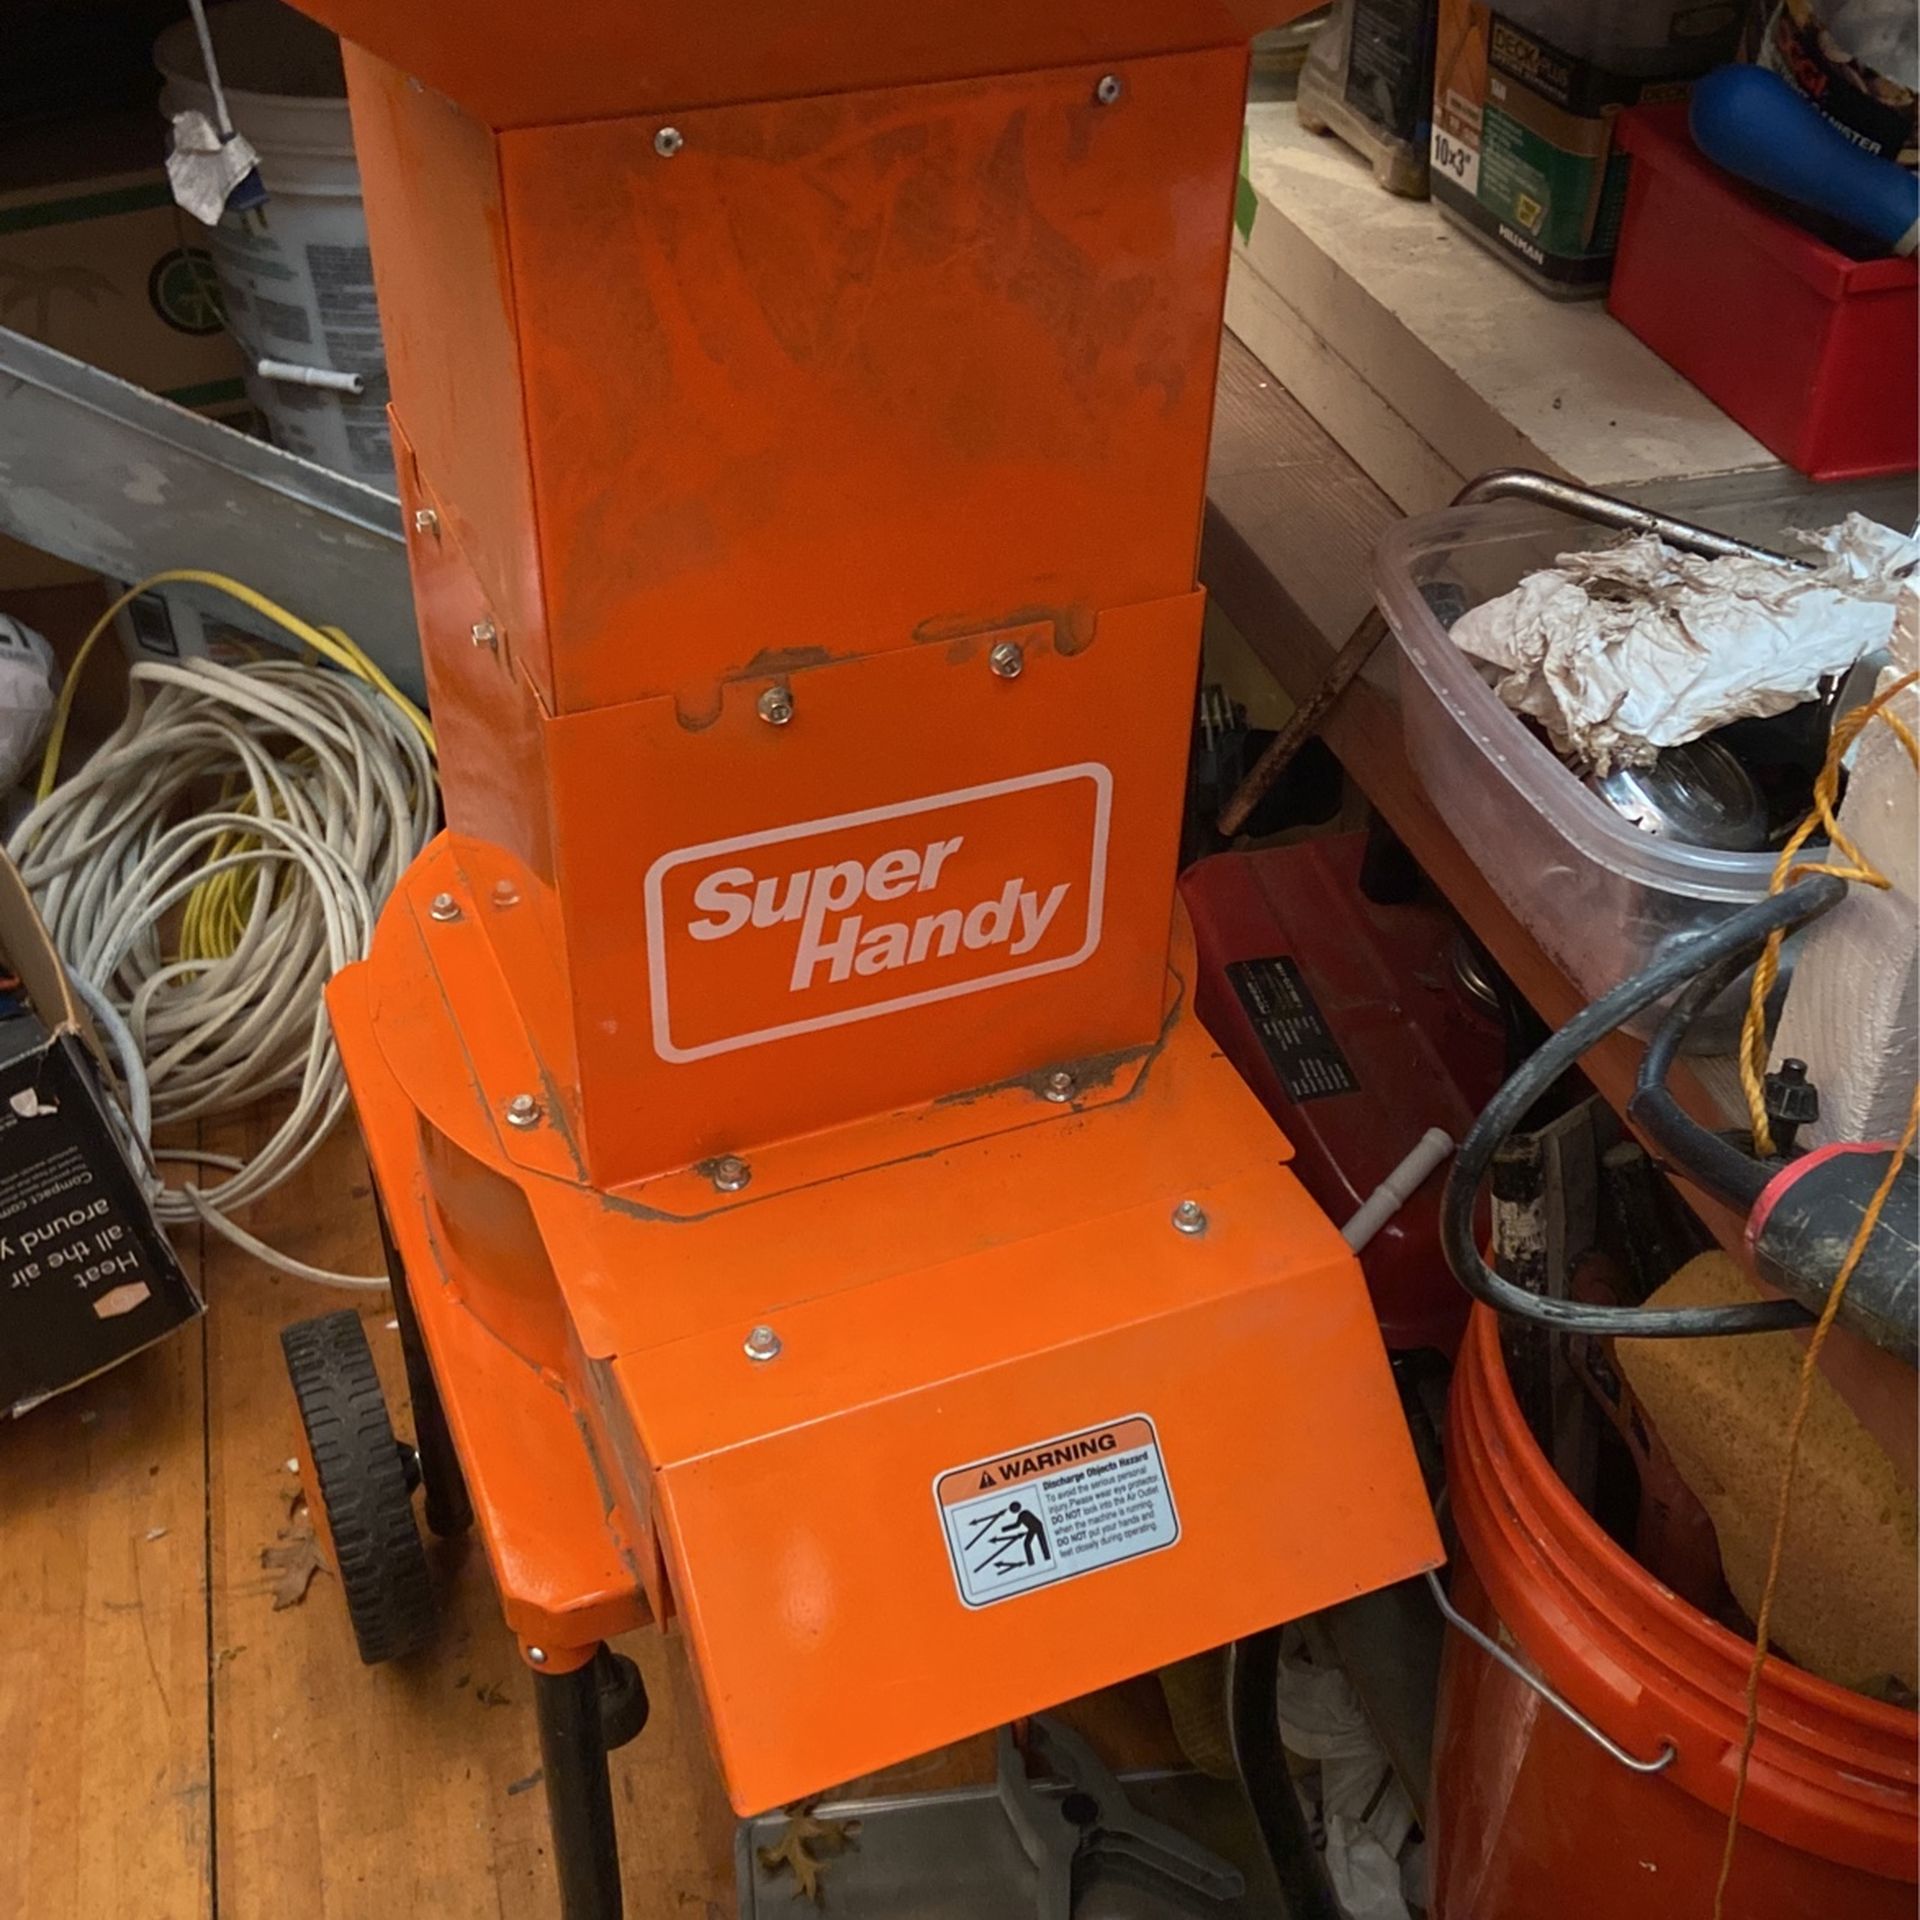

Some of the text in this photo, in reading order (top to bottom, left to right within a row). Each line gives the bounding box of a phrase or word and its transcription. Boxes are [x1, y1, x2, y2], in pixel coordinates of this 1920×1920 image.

[1493, 25, 1540, 70] DECK
[1499, 224, 1544, 265] HILLMAN
[687, 835, 964, 942] Super
[789, 878, 1071, 993] Handy
[30, 1171, 93, 1204] Compact
[20, 1198, 110, 1255] around
[11, 1225, 124, 1288] all the air
[73, 1250, 139, 1288] Heat
[998, 1434, 1117, 1480] WARNING
[1042, 1451, 1149, 1491] Discharge Objects Hazard
[1045, 1464, 1147, 1503] To avoid the serious personal
[1051, 1513, 1064, 1525] DO
[1065, 1507, 1081, 1520] NOT
[1087, 1510, 1117, 1525] machine
[1056, 1536, 1069, 1547] DO
[1070, 1530, 1086, 1542] NOT
